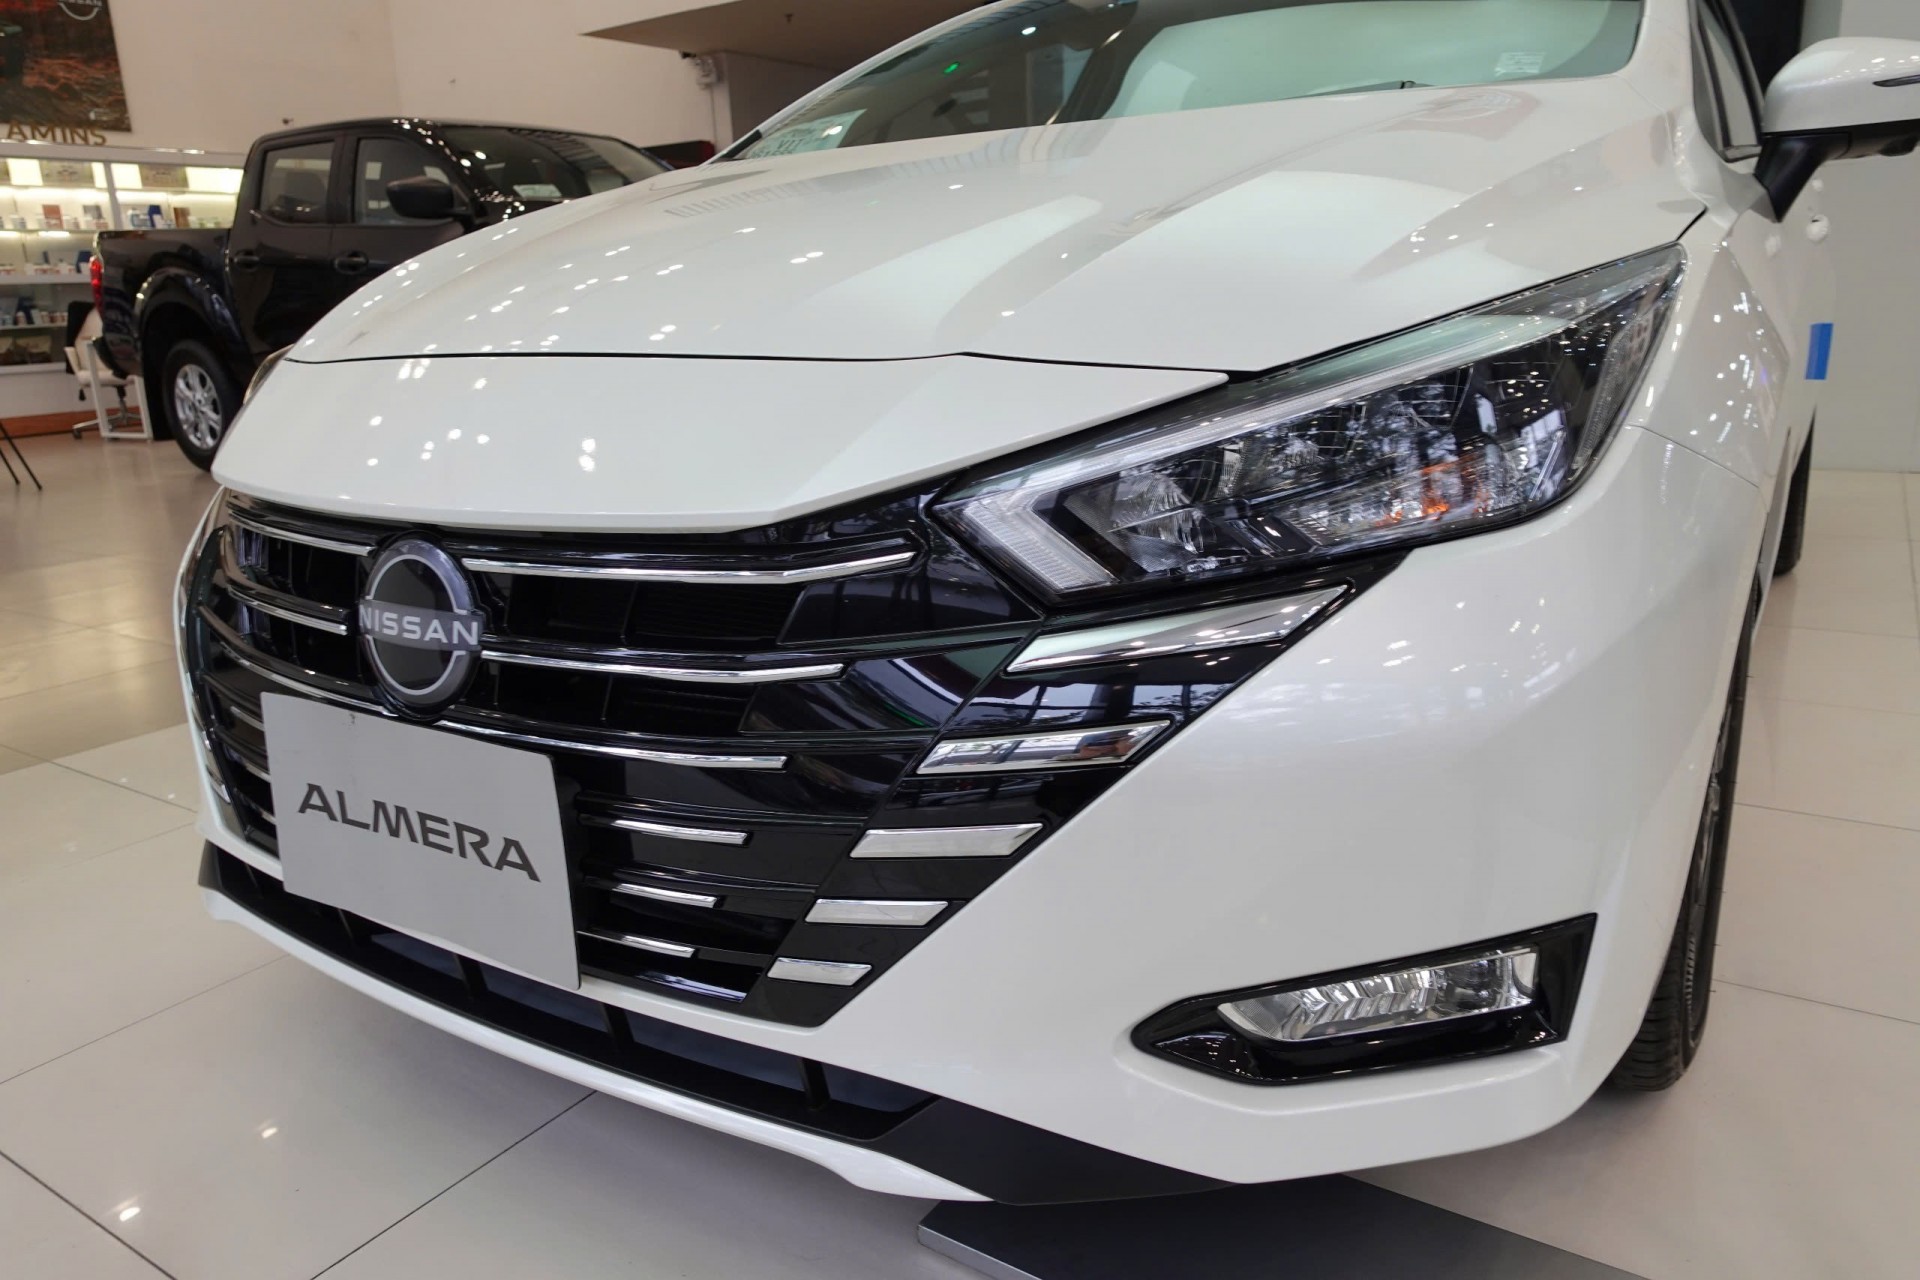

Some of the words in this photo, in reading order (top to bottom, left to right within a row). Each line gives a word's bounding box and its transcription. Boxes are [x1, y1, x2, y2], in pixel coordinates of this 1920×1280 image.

[7, 120, 107, 146] AMINS
[359, 604, 479, 645] NISSAN
[298, 783, 541, 882] ALMERA
